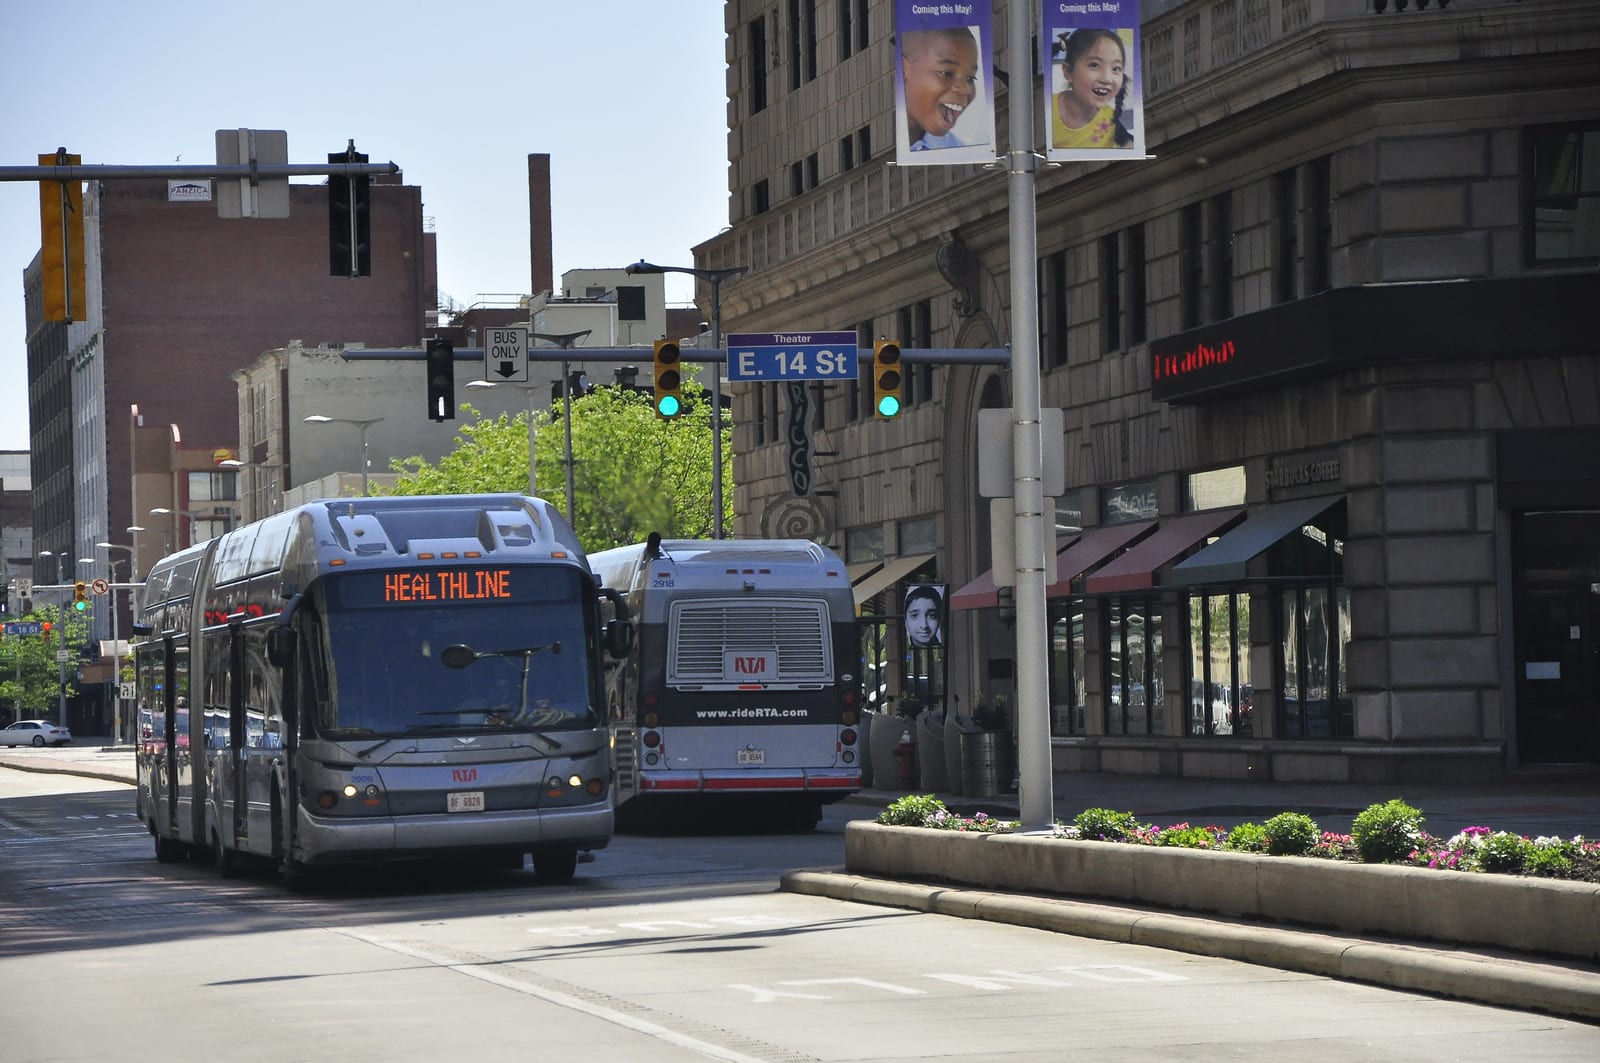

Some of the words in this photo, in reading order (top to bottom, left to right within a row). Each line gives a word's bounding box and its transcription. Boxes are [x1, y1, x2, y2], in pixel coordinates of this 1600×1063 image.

[912, 4, 939, 15] Coming
[940, 5, 953, 14] this
[955, 4, 972, 15] May!
[1060, 3, 1086, 14] Coming
[1088, 3, 1101, 12] this
[1103, 2, 1120, 13] May!
[494, 331, 517, 344] BUS
[773, 334, 812, 344] Theater
[491, 345, 521, 359] ONLY
[739, 352, 764, 376] E.
[774, 351, 807, 375] 14
[815, 349, 848, 375] St
[790, 382, 808, 491] RICCO
[1264, 463, 1310, 489] STARBUCKS
[1310, 459, 1341, 483] COFFEE
[385, 570, 511, 602] HEALTHLINE
[653, 579, 675, 588] 2918
[735, 656, 766, 674] RTA
[696, 707, 809, 719] www.rideRTA.com
[452, 768, 478, 783] RTA
[727, 964, 1189, 1003] ONLY
